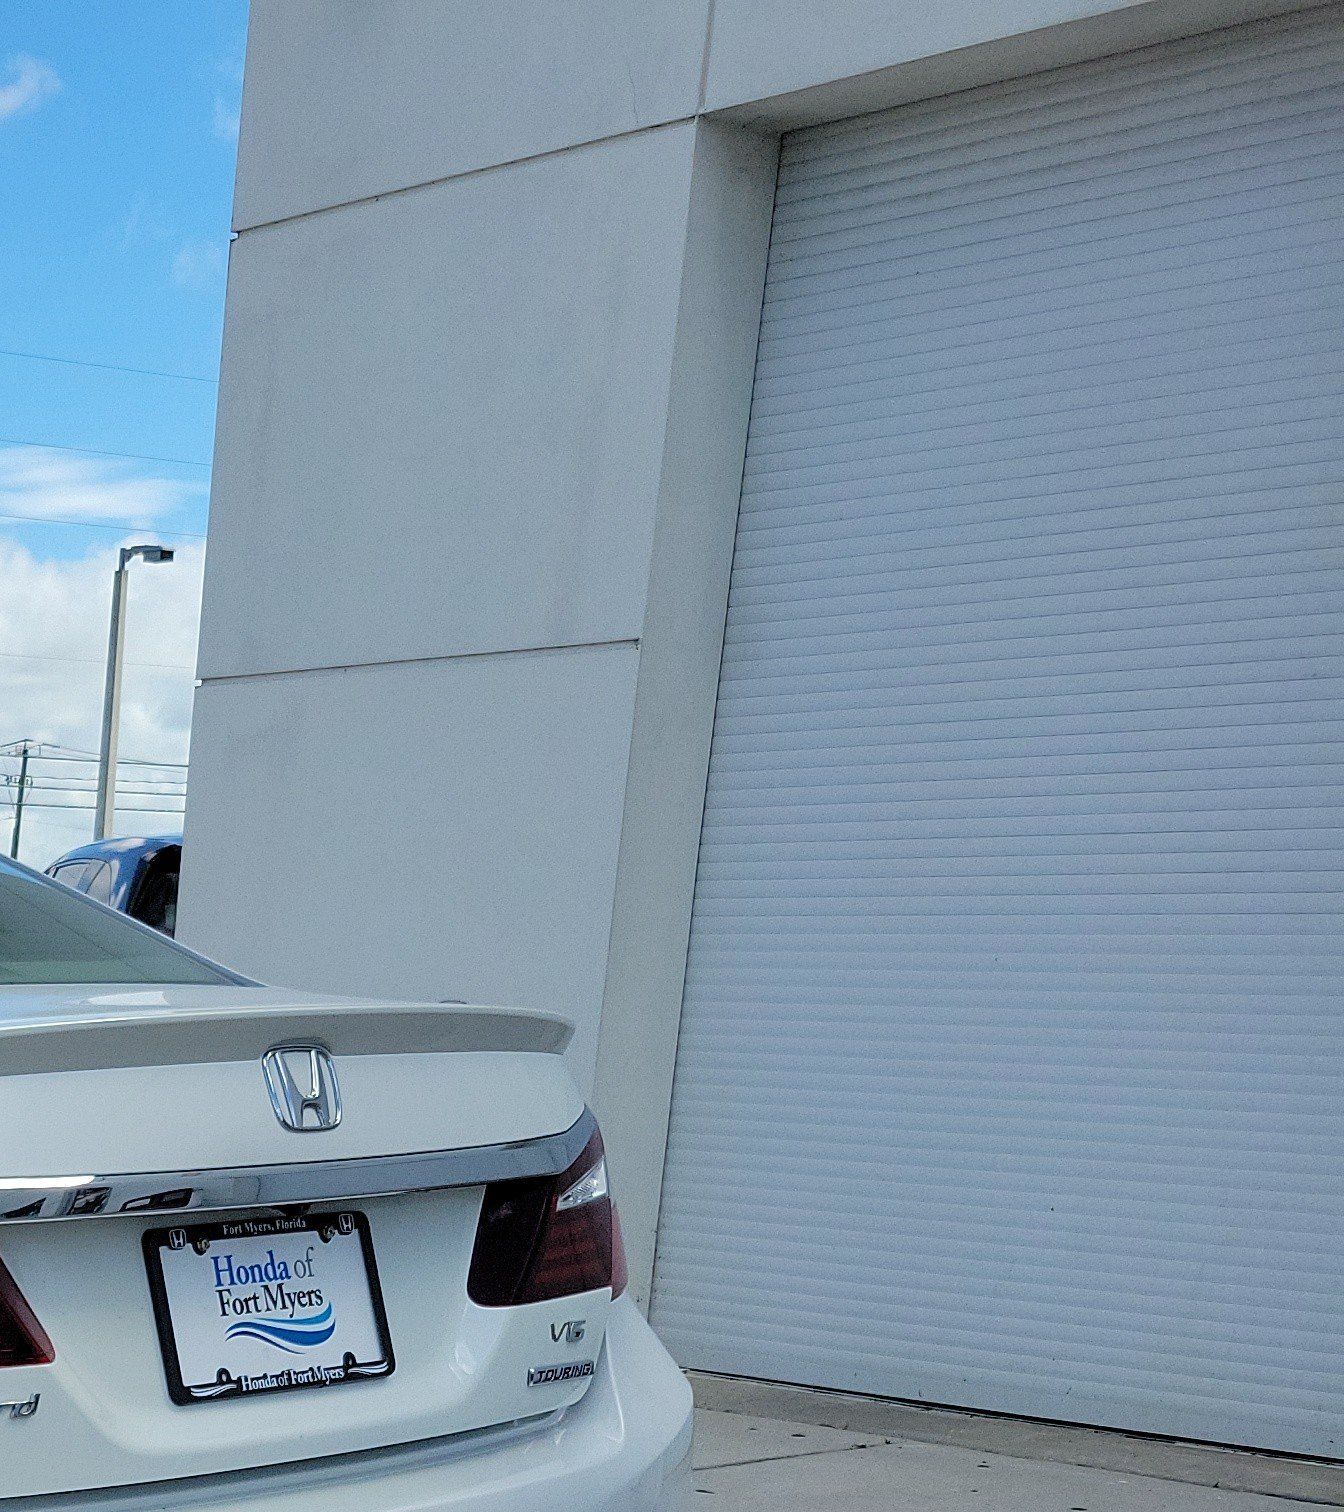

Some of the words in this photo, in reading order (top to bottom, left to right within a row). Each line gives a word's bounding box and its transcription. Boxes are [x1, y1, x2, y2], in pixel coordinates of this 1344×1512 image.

[223, 1224, 243, 1235] Fort
[245, 1221, 274, 1234] Myers,
[275, 1217, 306, 1230] Florida
[210, 1250, 291, 1287] Honda
[293, 1246, 315, 1278] of
[215, 1288, 261, 1317] Fort
[261, 1282, 324, 1318] Myers
[550, 1319, 587, 1343] V6
[241, 1373, 278, 1392] Honda
[278, 1370, 289, 1386] of
[290, 1369, 314, 1384] Fort
[314, 1366, 345, 1385] Myers
[536, 1363, 592, 1384] TOURING
